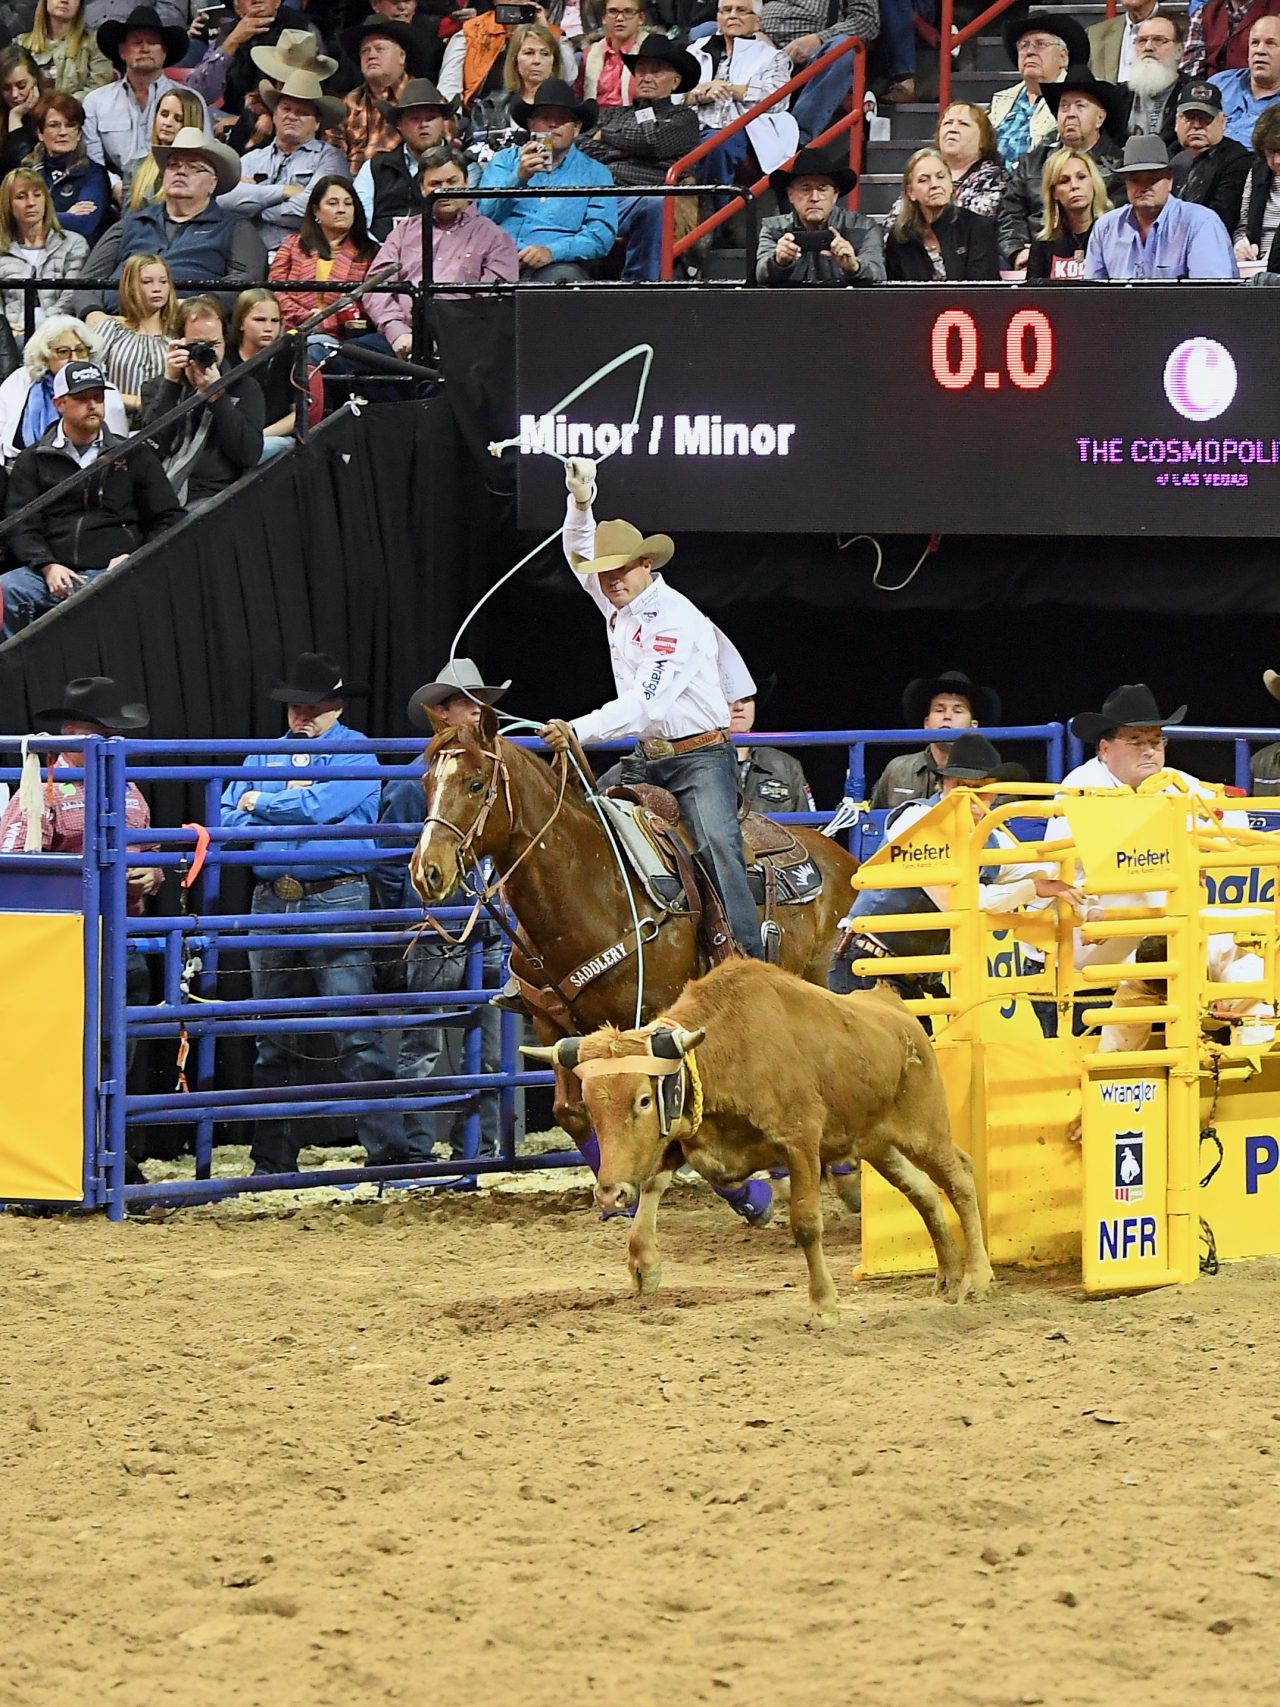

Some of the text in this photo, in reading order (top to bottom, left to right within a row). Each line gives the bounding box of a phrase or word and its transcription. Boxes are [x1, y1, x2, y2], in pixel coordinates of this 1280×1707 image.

[931, 309, 1052, 389] 0.0
[519, 414, 796, 456] Minor / Minor
[1076, 438, 1124, 464] THE
[890, 842, 950, 863] Priefert
[1116, 849, 1170, 868] Priefert
[569, 942, 628, 988] SADDLERY
[1100, 1082, 1157, 1112] Wrangler
[1100, 1215, 1156, 1261] NFR
